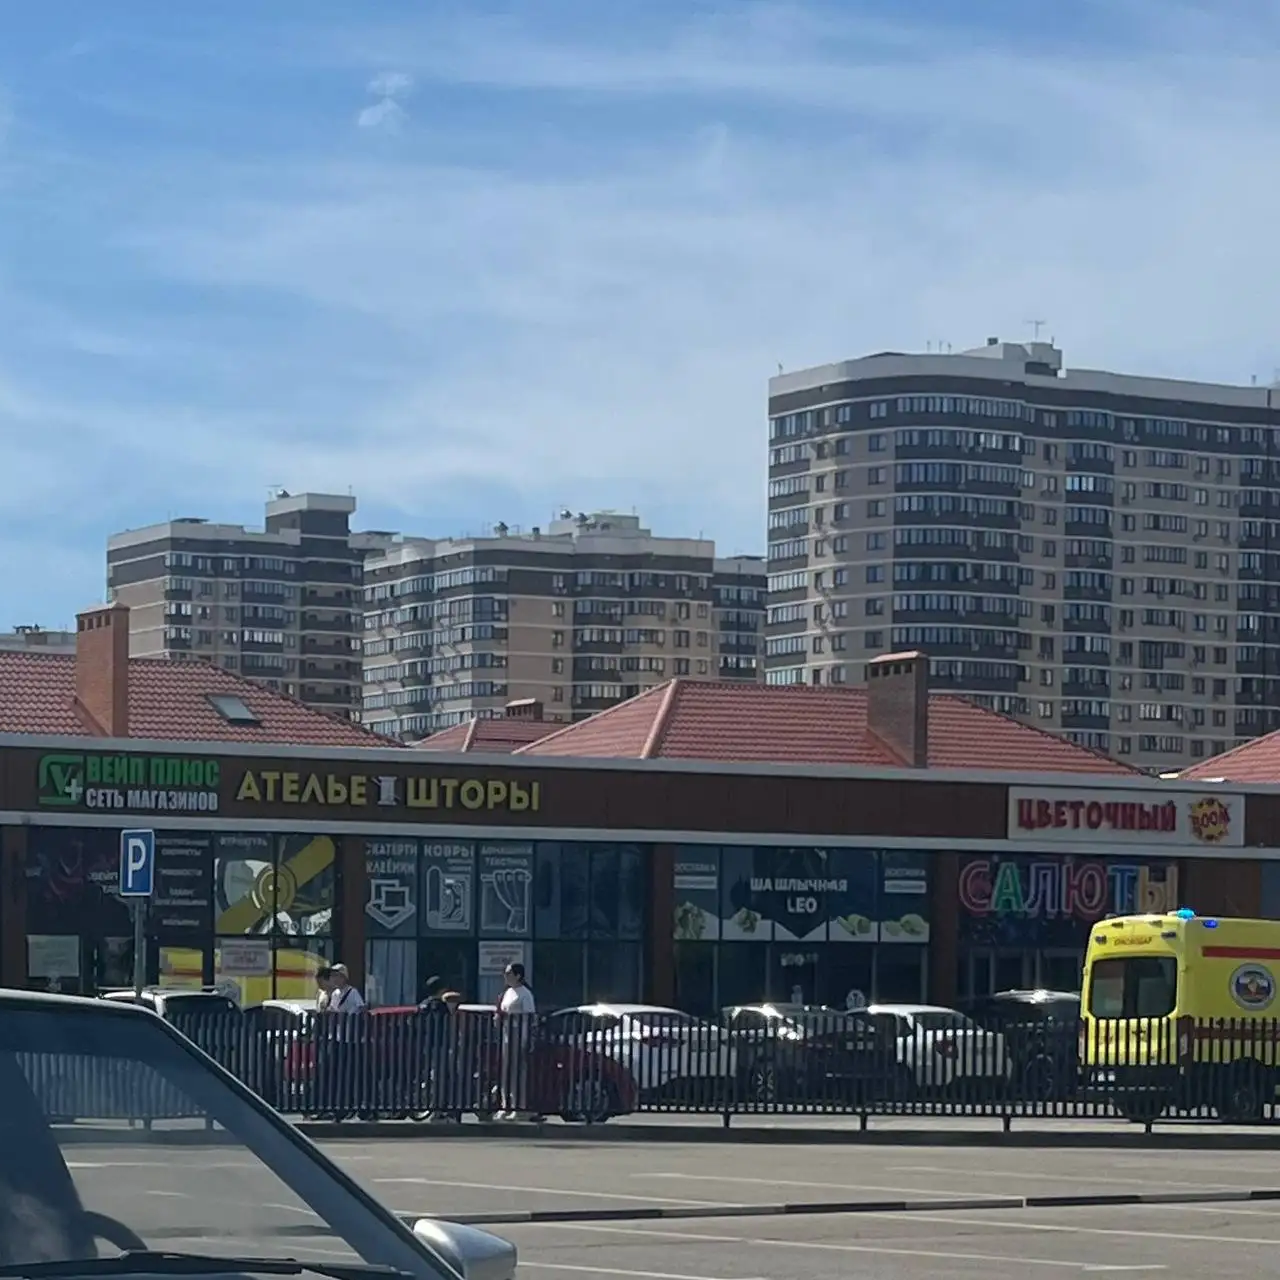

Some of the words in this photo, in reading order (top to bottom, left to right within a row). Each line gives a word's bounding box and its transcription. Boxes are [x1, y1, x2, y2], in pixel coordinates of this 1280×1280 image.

[86, 753, 144, 785] ВЕЙП
[150, 757, 219, 787] ПЛЮС
[86, 788, 124, 808] СЕТЬ
[127, 789, 218, 811] МАГАЗИНОВ
[236, 770, 367, 806] АТЕЛЬЕ
[406, 776, 539, 811] ШТОРЫ
[1017, 798, 1177, 832] ЦВЕТОЧНЫЙ
[128, 838, 147, 888] P
[423, 844, 475, 858] КОВРЫ
[786, 896, 818, 914] LEO
[958, 856, 1180, 920] САЛЮТЫ
